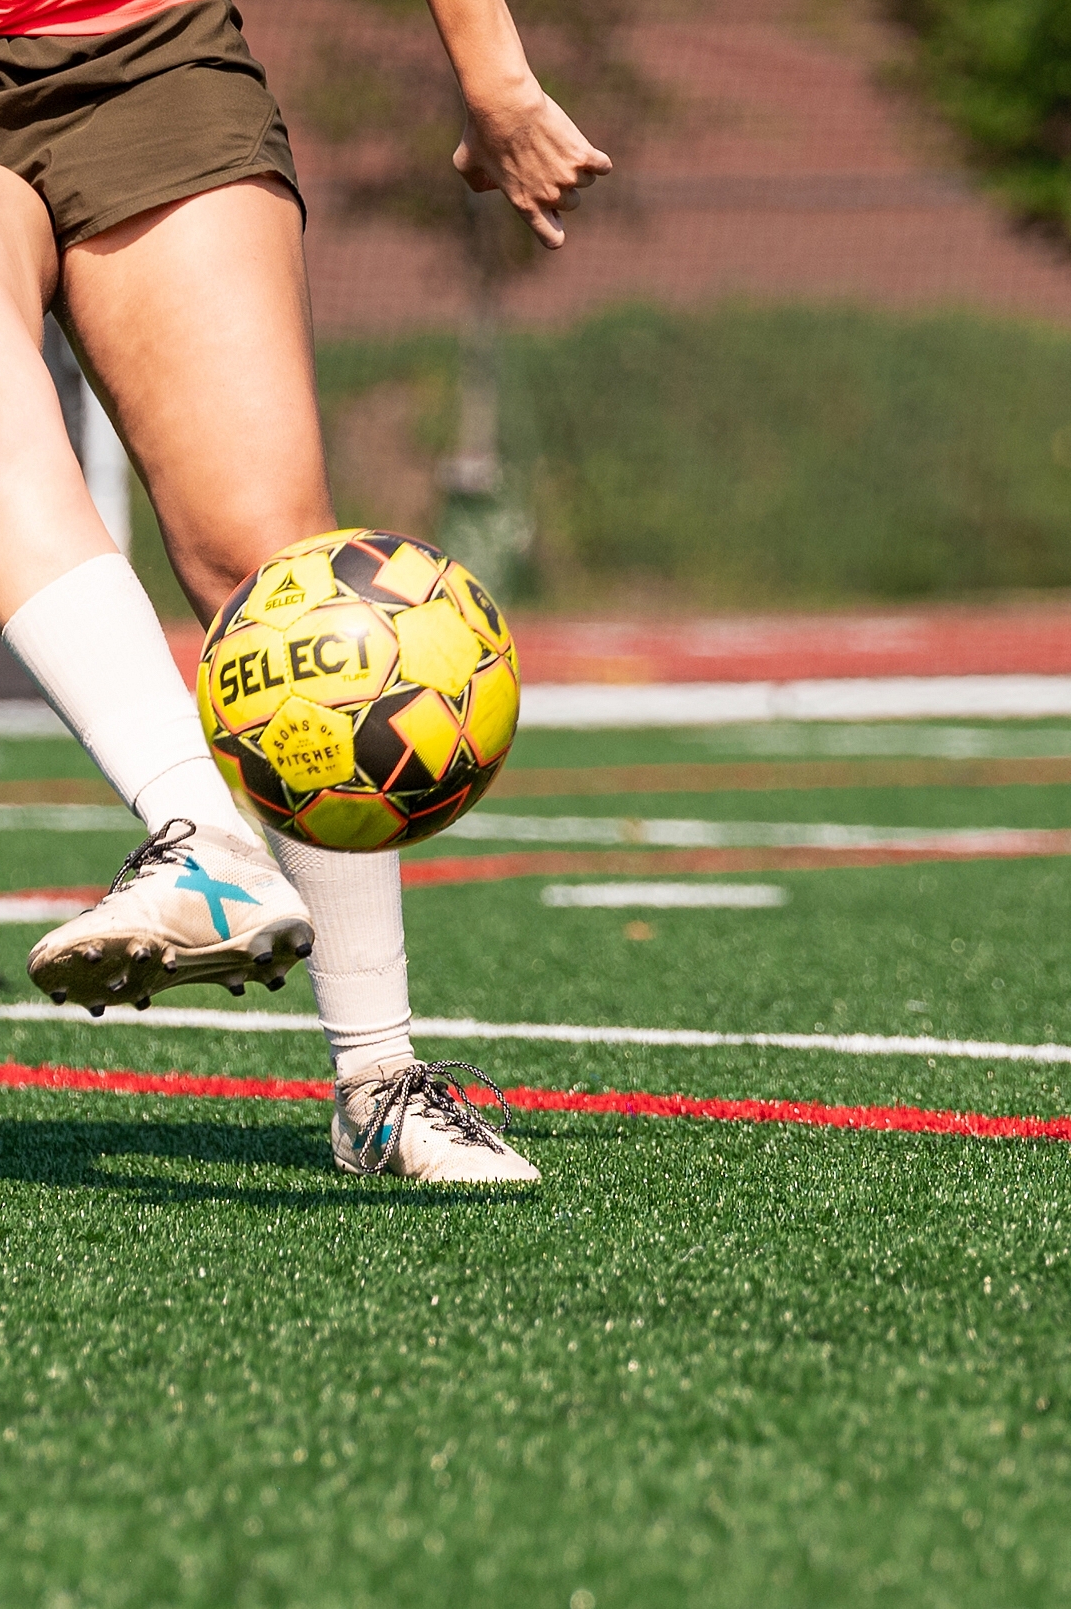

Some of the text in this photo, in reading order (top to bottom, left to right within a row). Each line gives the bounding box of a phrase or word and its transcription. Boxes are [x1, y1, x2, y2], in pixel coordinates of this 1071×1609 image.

[264, 593, 306, 612] SELECT
[219, 629, 371, 707] SELECT
[274, 720, 309, 750] SONS
